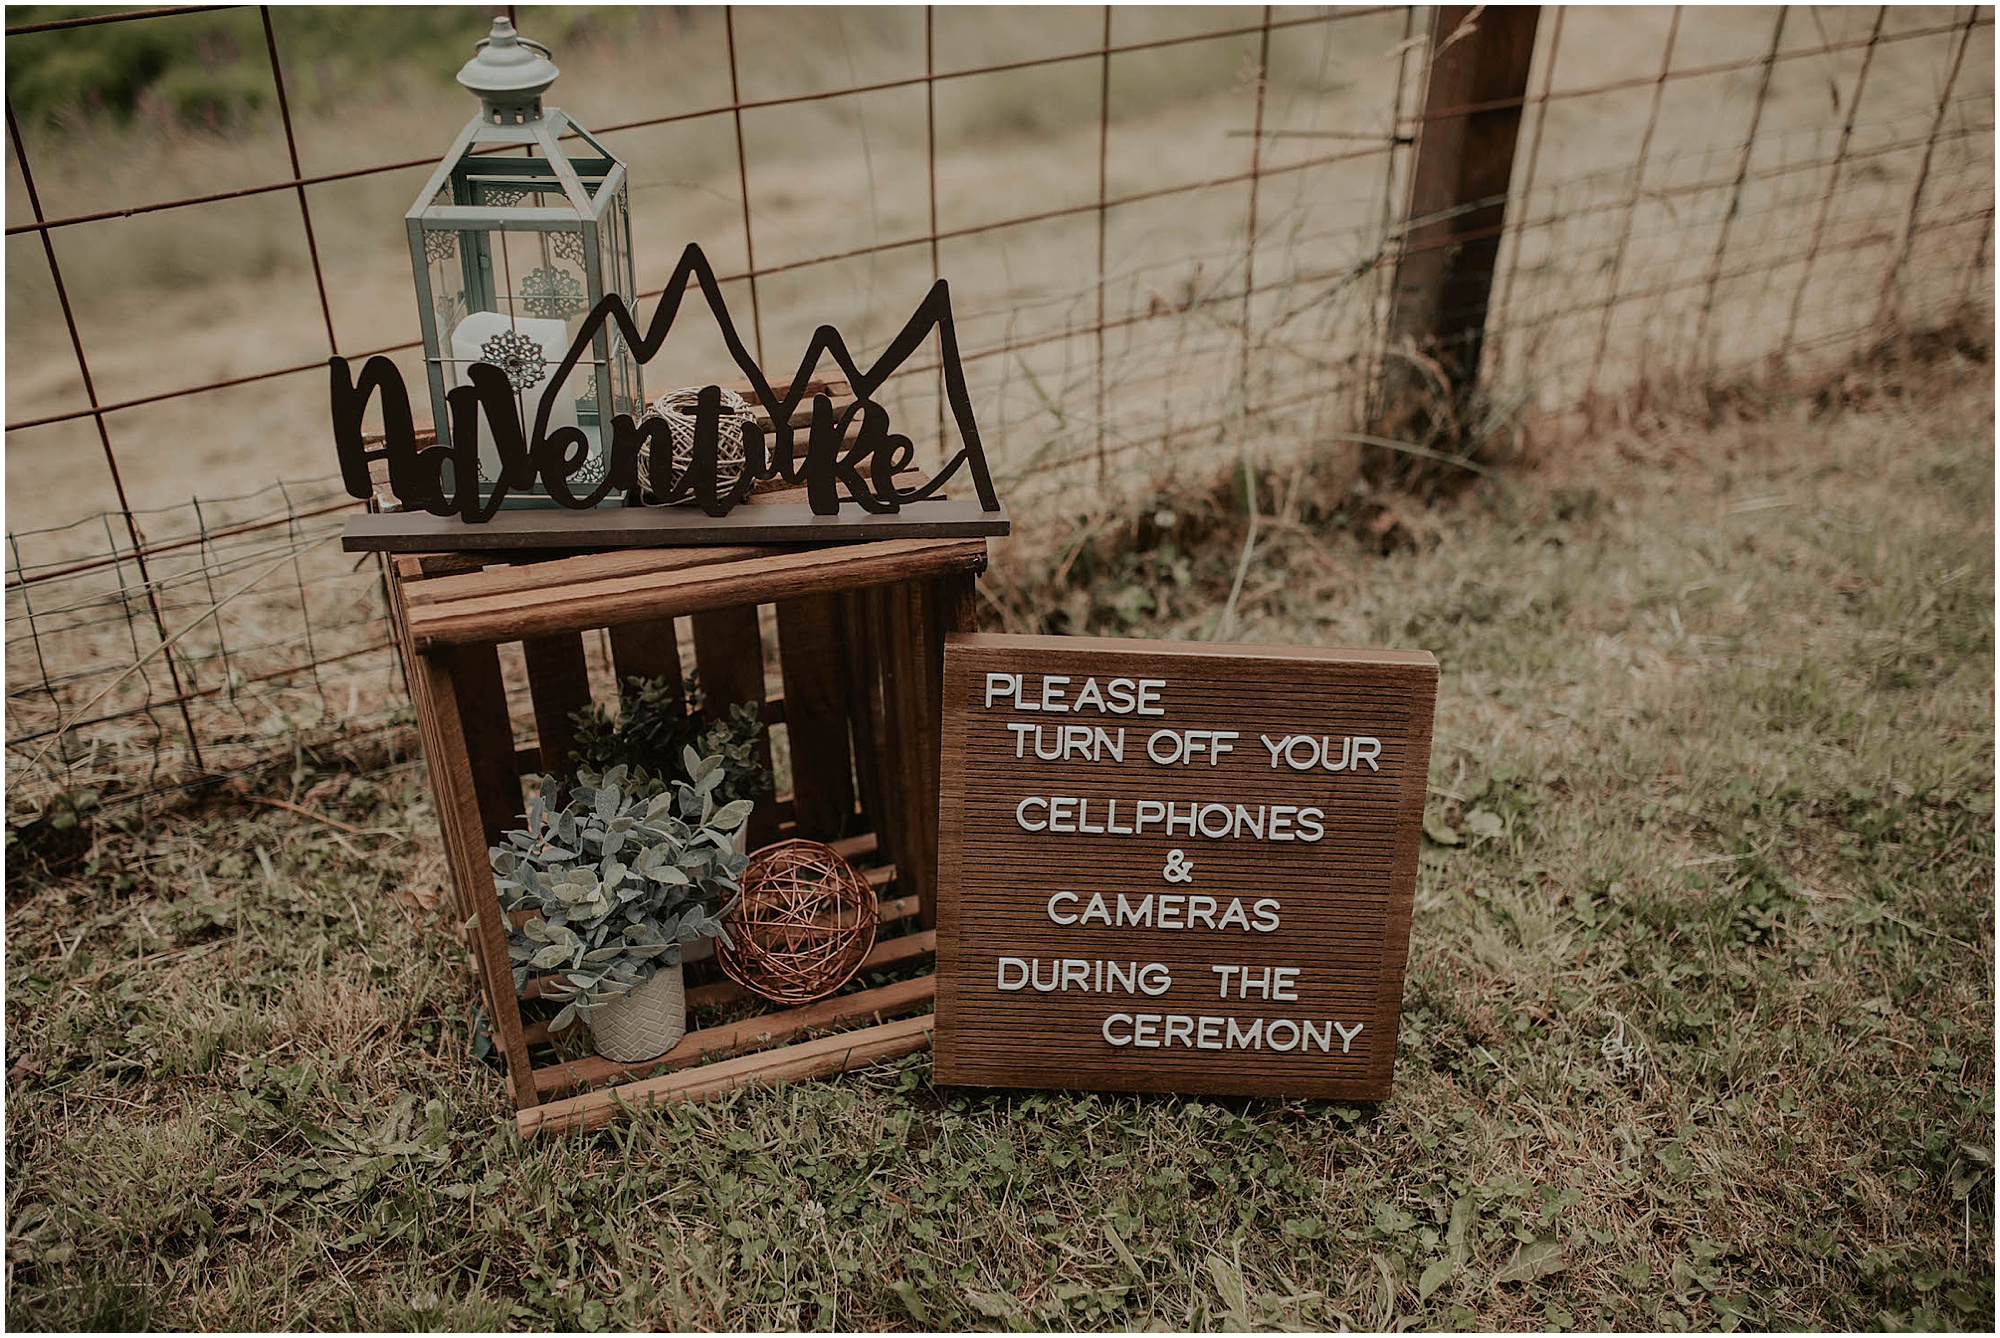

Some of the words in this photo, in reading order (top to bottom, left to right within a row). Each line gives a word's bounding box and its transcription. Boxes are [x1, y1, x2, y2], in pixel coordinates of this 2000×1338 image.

[985, 672, 1167, 716] PLEASE
[1006, 722, 1126, 763] TURN
[1147, 729, 1240, 766] OFF
[1260, 734, 1382, 772] YOUR
[1016, 796, 1325, 842] CELLPHONES
[1162, 848, 1194, 884] &
[1047, 891, 1282, 932] CAMERAS
[997, 957, 1172, 996] DURING
[1211, 965, 1301, 1001] THE
[1102, 1013, 1364, 1054] CEREMONY
